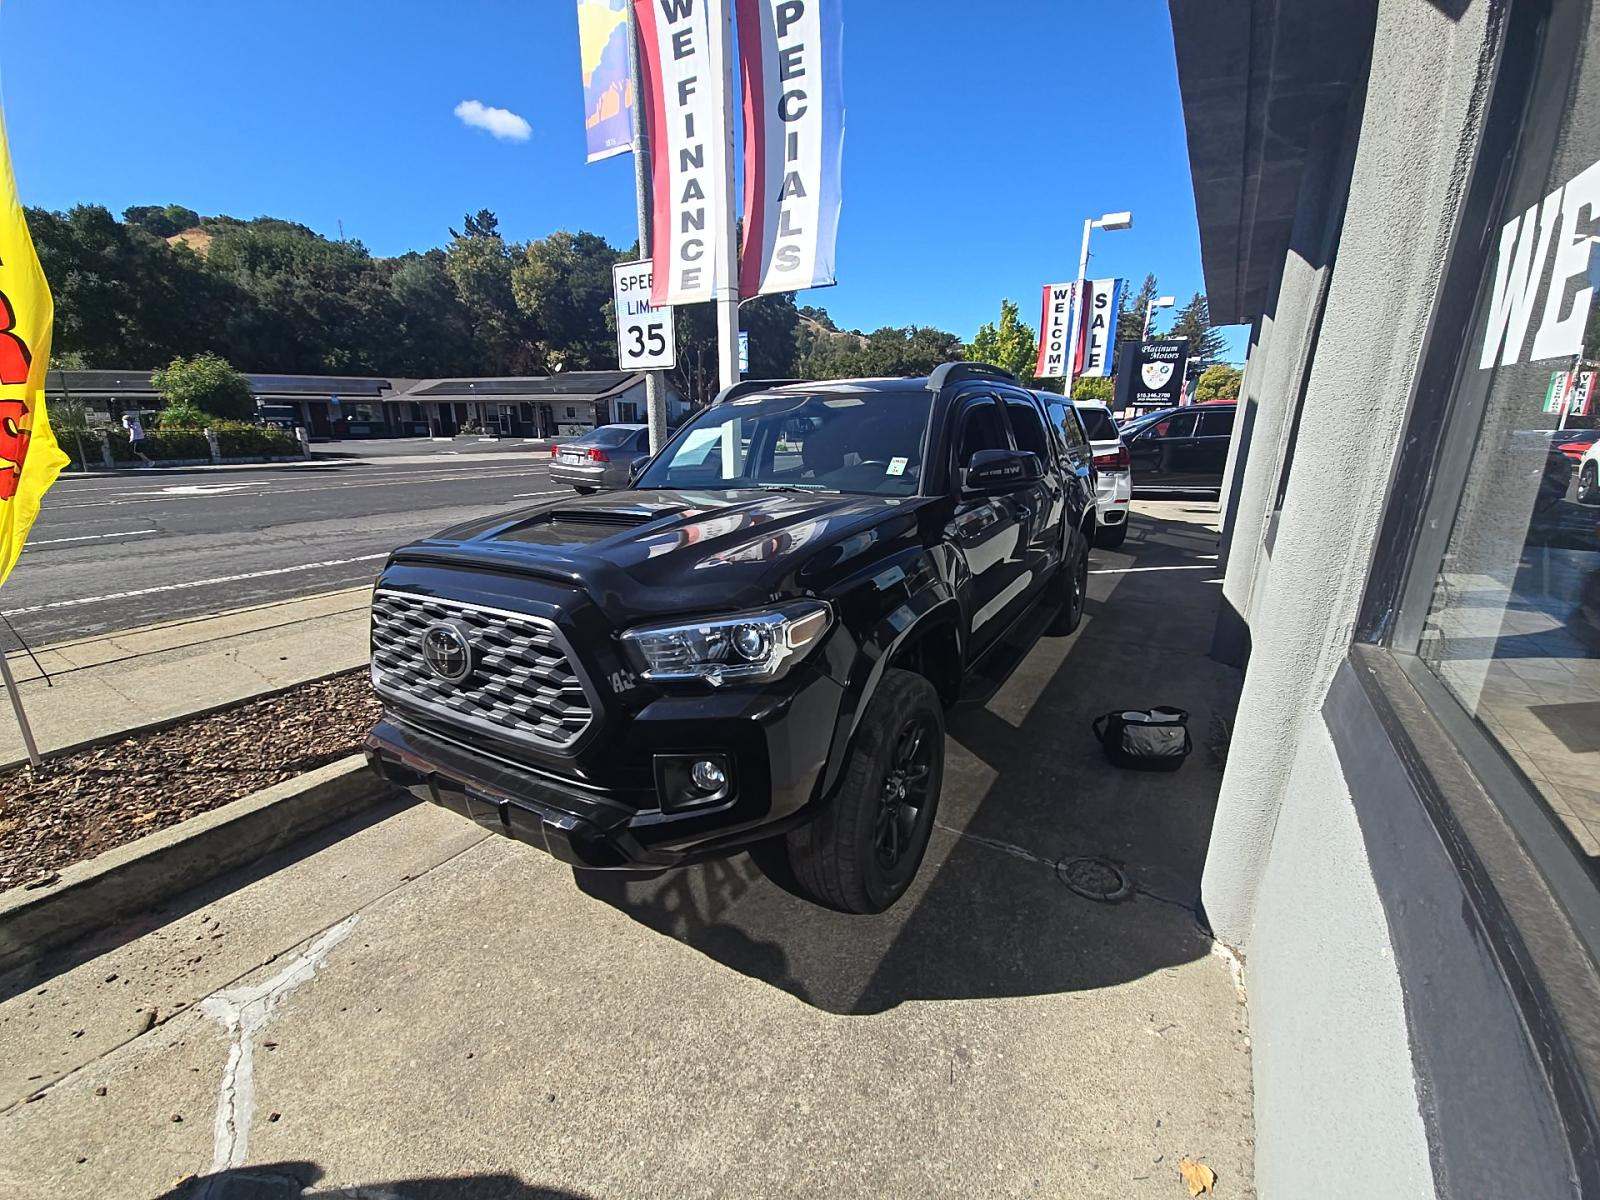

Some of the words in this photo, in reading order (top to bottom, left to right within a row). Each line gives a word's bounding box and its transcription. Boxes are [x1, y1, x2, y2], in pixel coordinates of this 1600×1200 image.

[677, 75, 707, 291] FINANCE
[620, 273, 654, 292] SPEE
[1480, 160, 1600, 371] WE
[627, 322, 666, 358] 35
[1048, 289, 1068, 375] WELCOME
[1088, 293, 1108, 368] SALE
[1141, 344, 1179, 354] Platinum
[1150, 352, 1180, 360] Motors
[1573, 374, 1590, 413] VENTA
